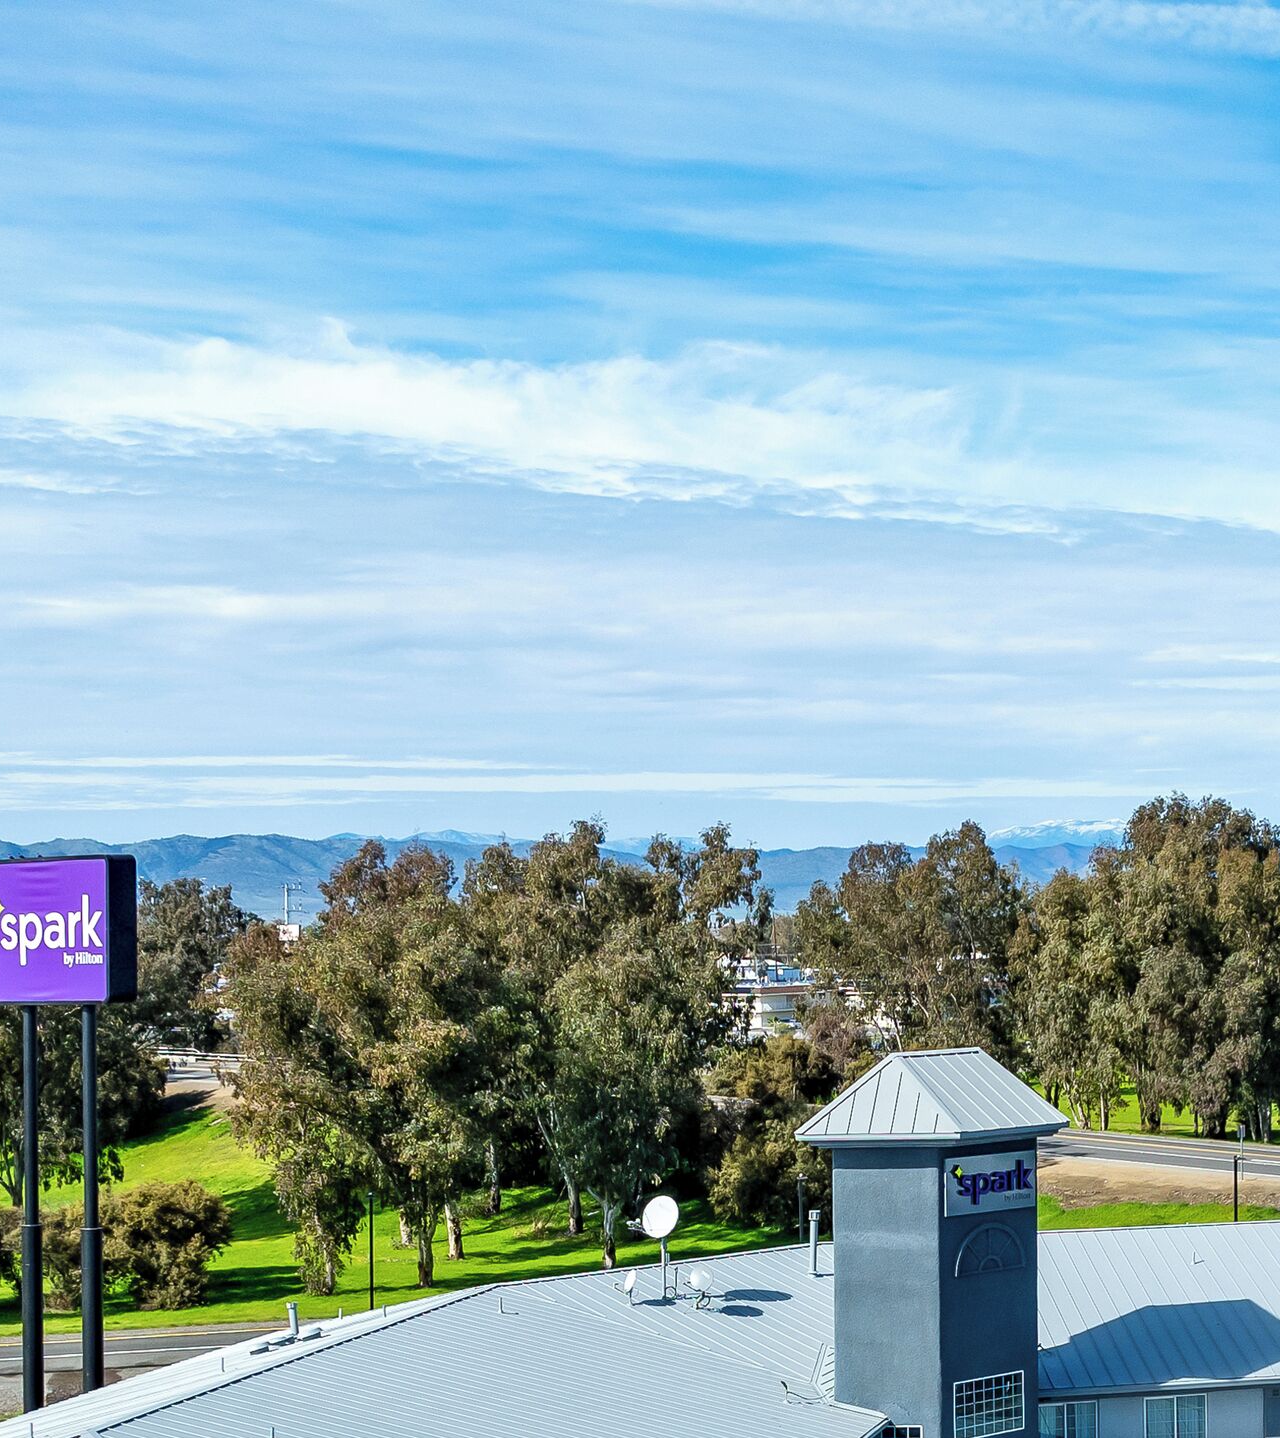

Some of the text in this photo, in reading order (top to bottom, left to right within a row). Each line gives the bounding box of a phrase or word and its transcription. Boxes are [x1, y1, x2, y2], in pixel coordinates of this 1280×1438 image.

[0, 894, 104, 966] spark
[63, 951, 104, 968] by Hilton
[958, 1160, 1033, 1205] spark
